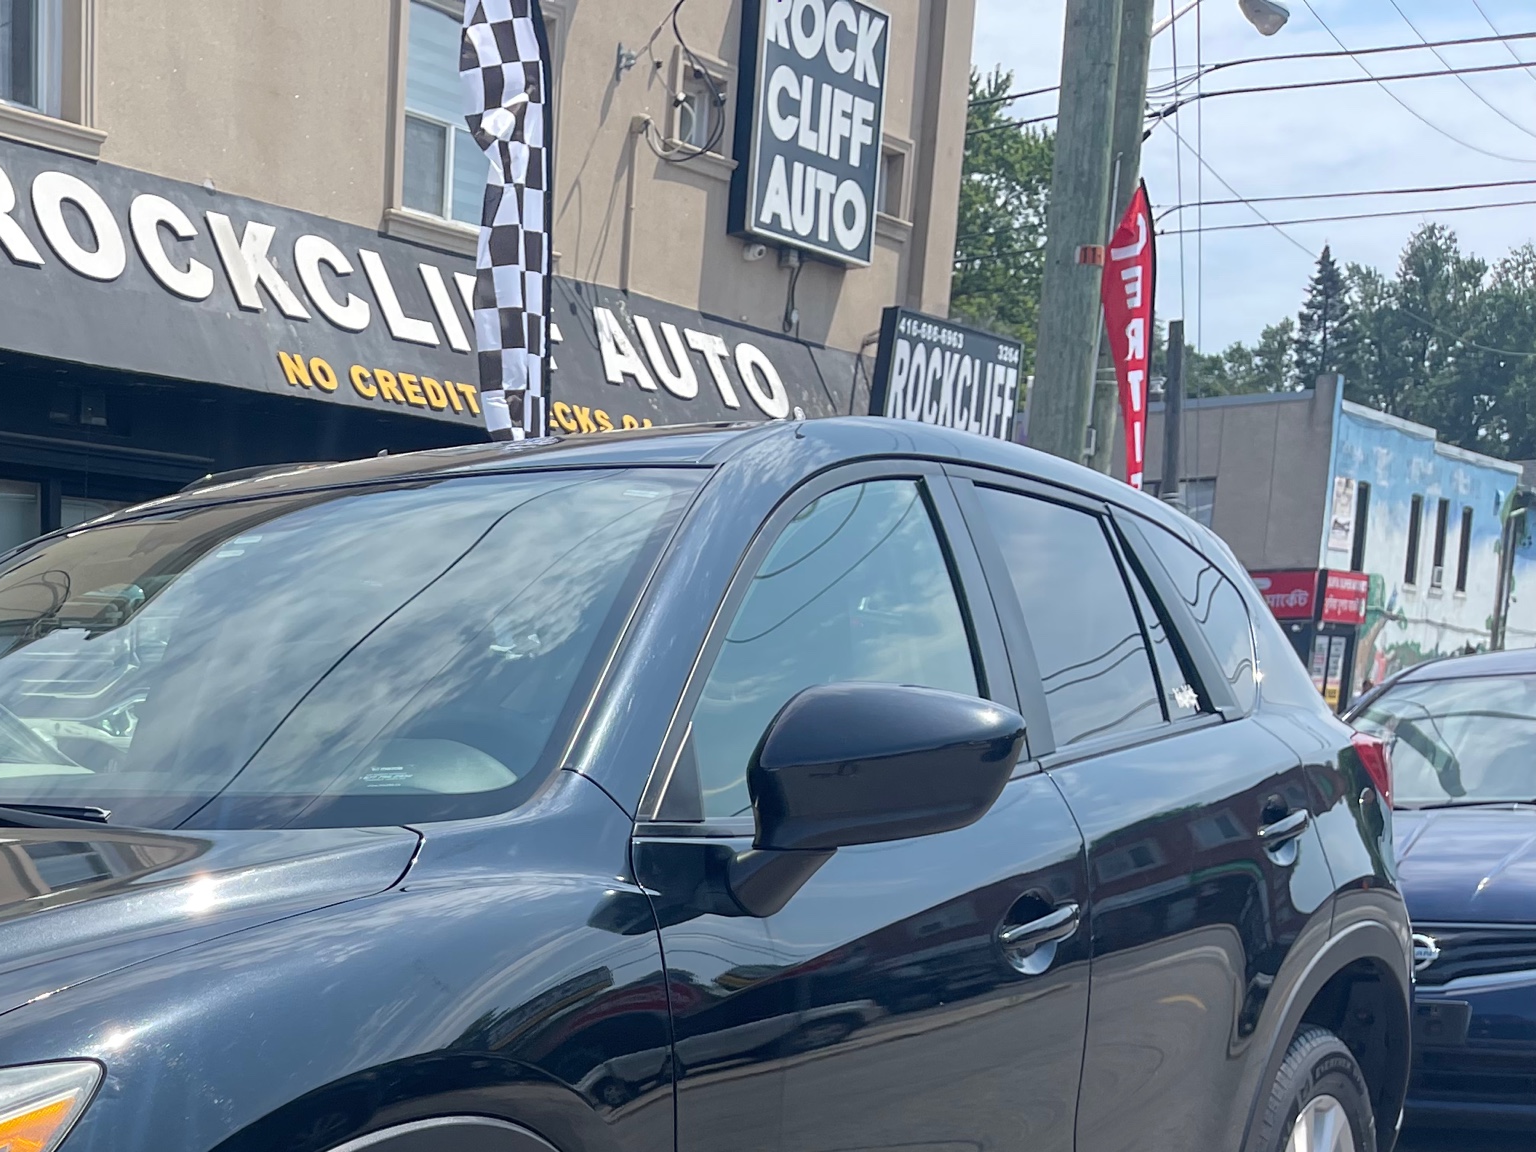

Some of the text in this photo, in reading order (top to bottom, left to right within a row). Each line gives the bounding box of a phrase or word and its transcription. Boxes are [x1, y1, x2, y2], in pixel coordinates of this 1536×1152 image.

[766, 0, 885, 88] ROCK
[768, 65, 874, 167] CLIFF
[760, 154, 867, 251] AUTO
[278, 351, 338, 390] NO
[350, 364, 481, 414] CREDIT
[593, 306, 790, 420] AUTO
[887, 338, 1017, 442] ROCKCLIFF
